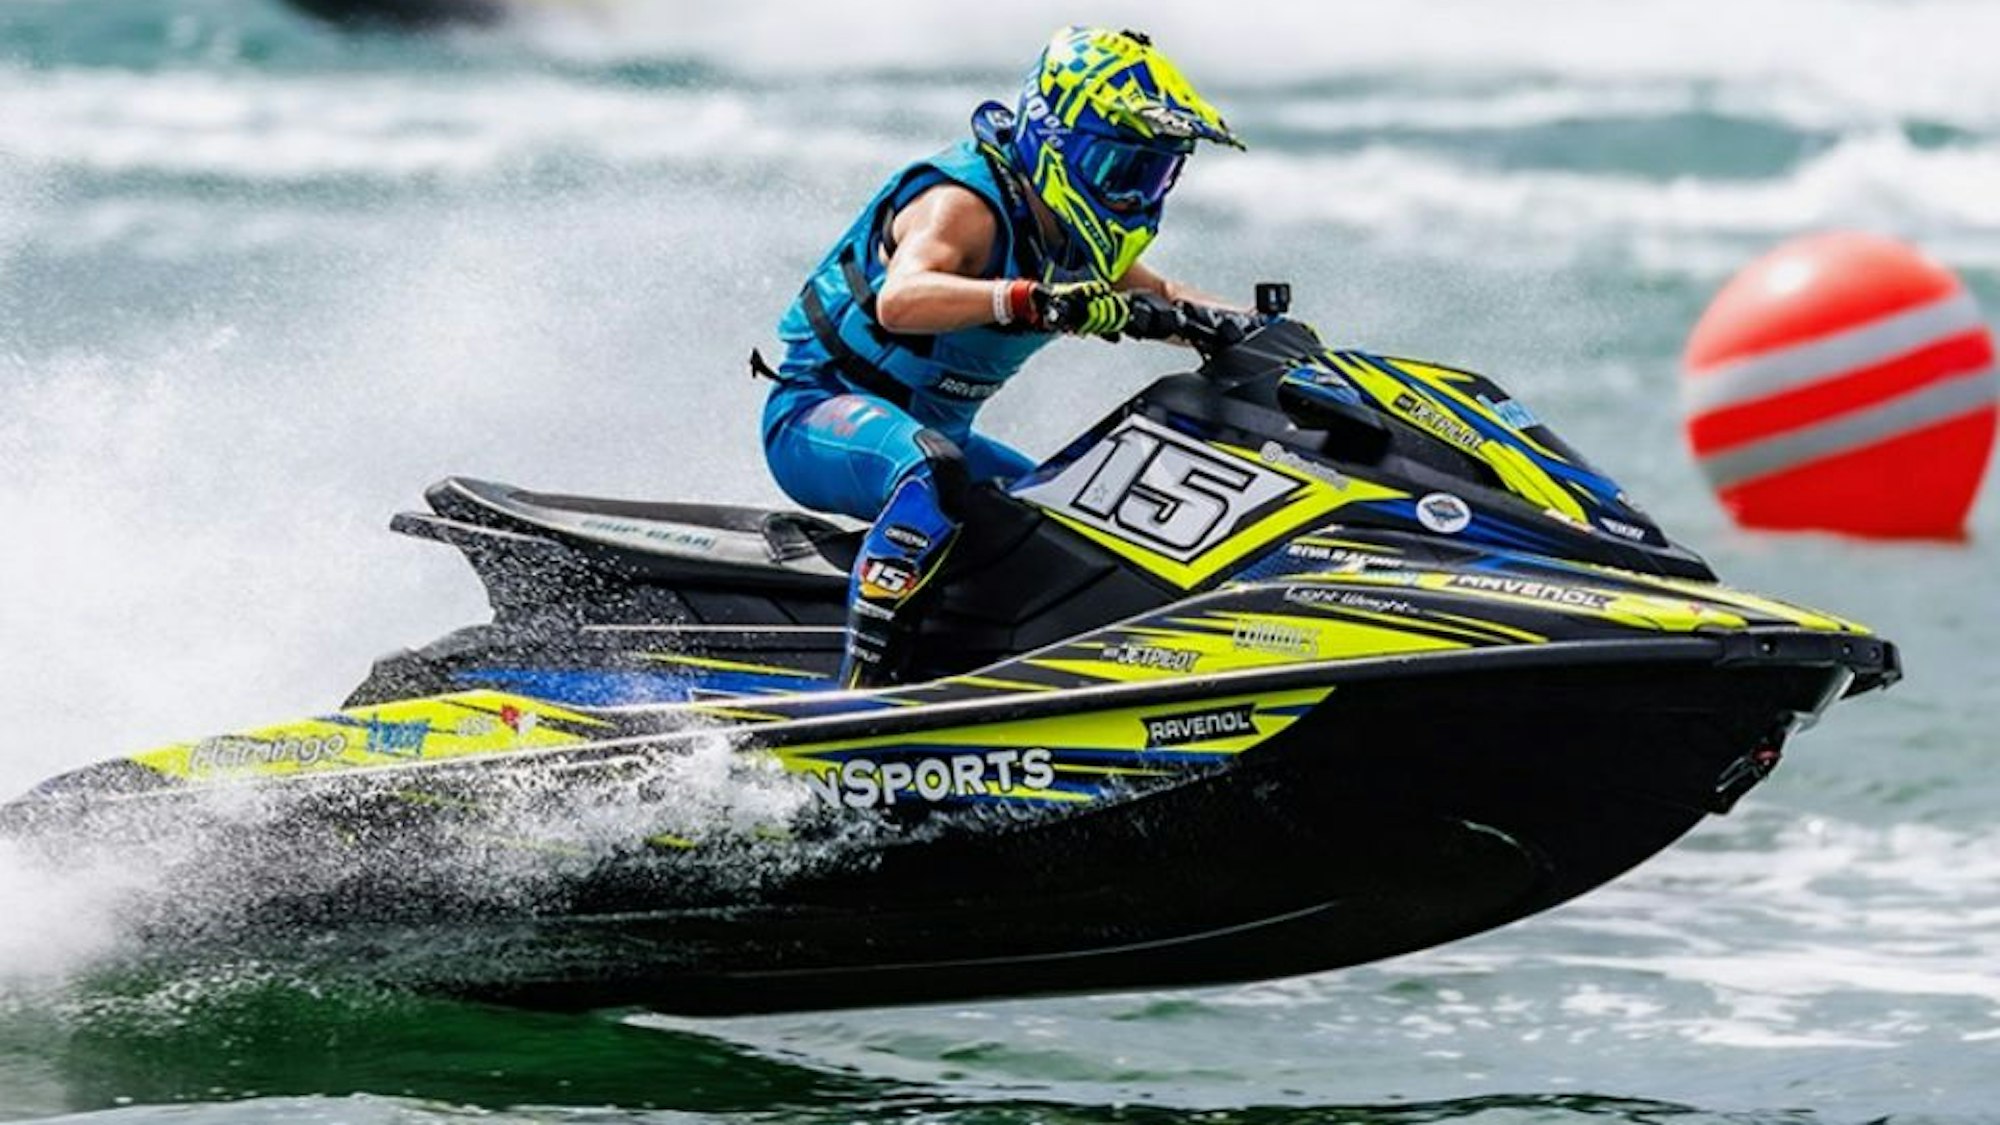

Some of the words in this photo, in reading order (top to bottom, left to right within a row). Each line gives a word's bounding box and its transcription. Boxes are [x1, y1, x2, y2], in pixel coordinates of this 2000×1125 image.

[1071, 427, 1257, 551] 15
[865, 561, 910, 591] 15
[1457, 574, 1606, 606] RAVENOL
[1117, 643, 1199, 672] JETPILOT
[1150, 711, 1250, 740] RAVENOL
